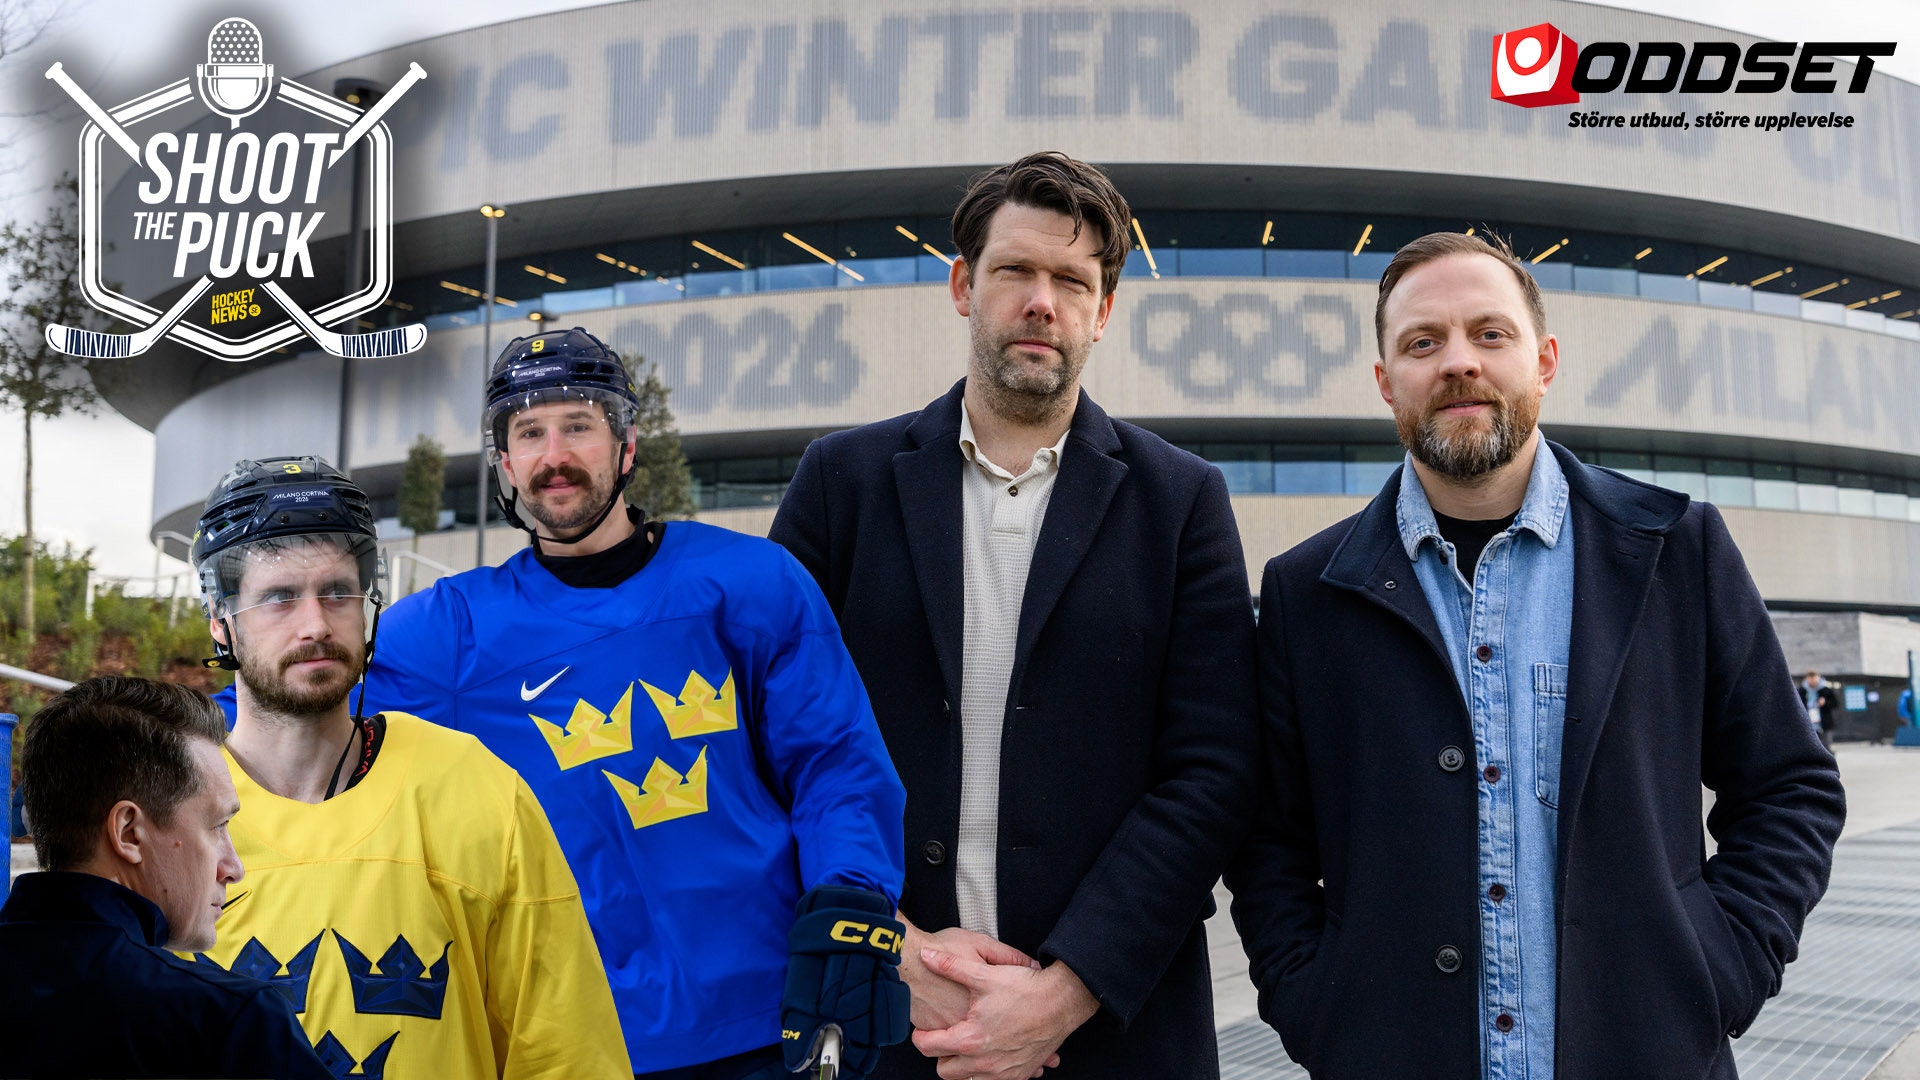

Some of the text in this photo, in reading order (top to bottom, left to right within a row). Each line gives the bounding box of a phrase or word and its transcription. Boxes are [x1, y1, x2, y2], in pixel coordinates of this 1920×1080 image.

[605, 9, 1199, 147] WINTER
[531, 339, 545, 353] 9
[283, 464, 302, 474] 3
[273, 490, 330, 500] MILANO CORTINA
